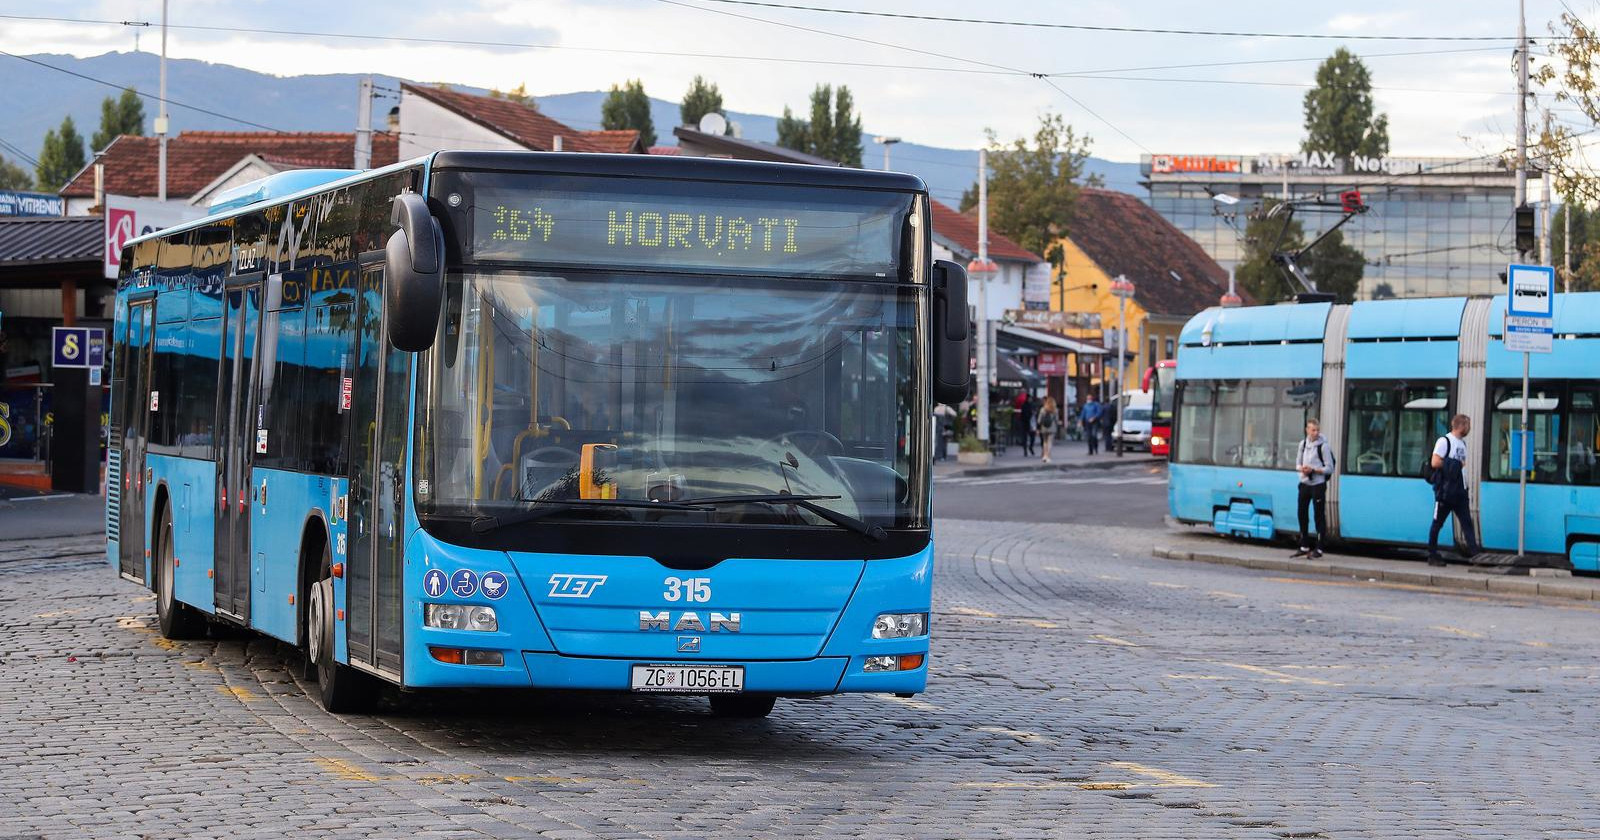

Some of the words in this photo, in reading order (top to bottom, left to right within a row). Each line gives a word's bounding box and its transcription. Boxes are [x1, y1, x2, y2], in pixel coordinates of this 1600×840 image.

[493, 206, 555, 241] 164
[608, 211, 798, 252] HORVATI
[548, 574, 608, 598] ZET
[663, 577, 712, 602] 315
[639, 611, 741, 632] MAN
[645, 669, 665, 686] ZG
